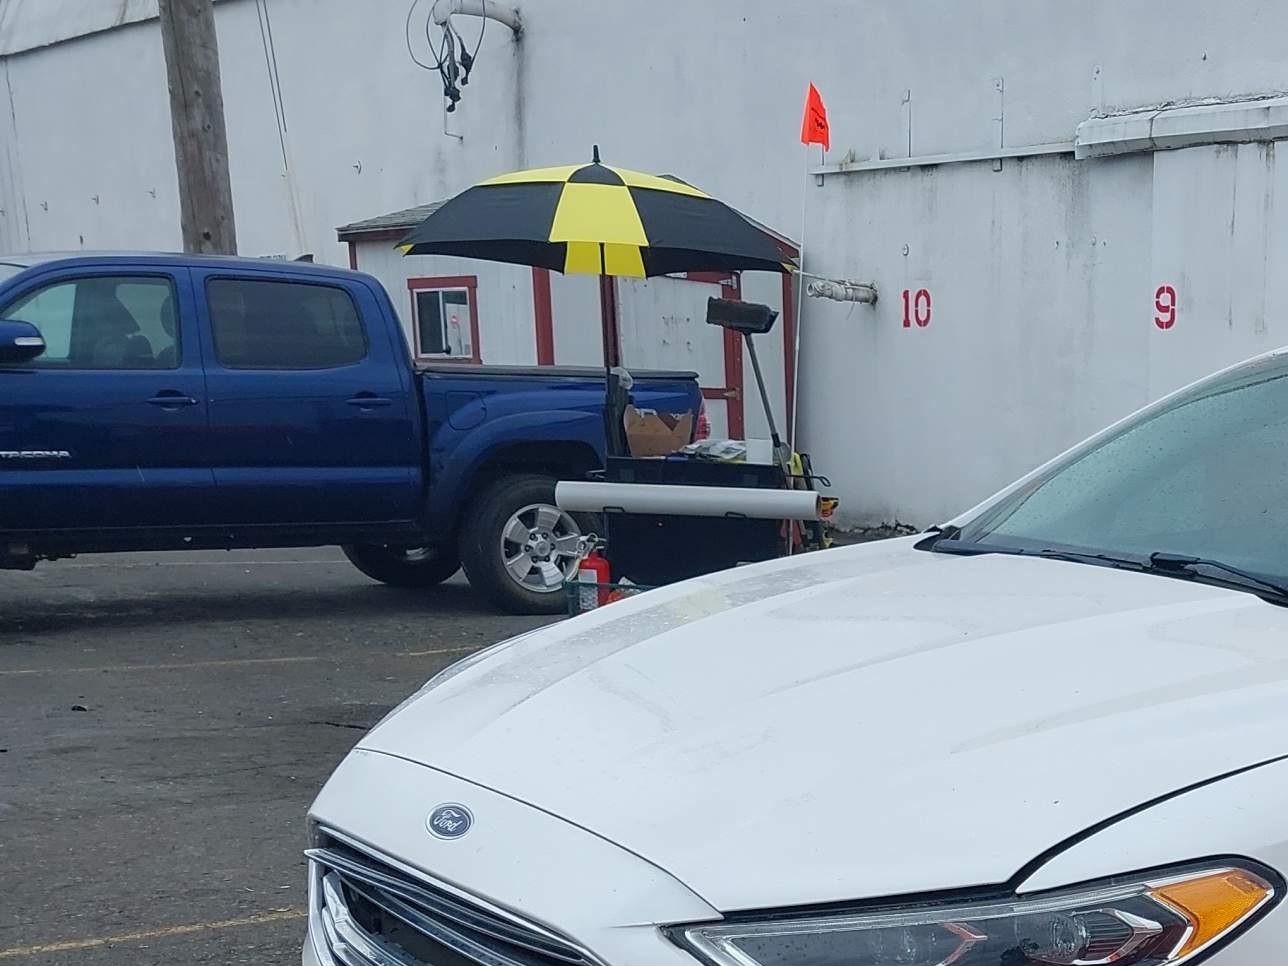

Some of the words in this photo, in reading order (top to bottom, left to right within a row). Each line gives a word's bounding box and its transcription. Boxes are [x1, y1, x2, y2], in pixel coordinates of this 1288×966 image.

[902, 288, 932, 328] 10
[1155, 286, 1176, 330] 9
[433, 809, 463, 832] Ford
